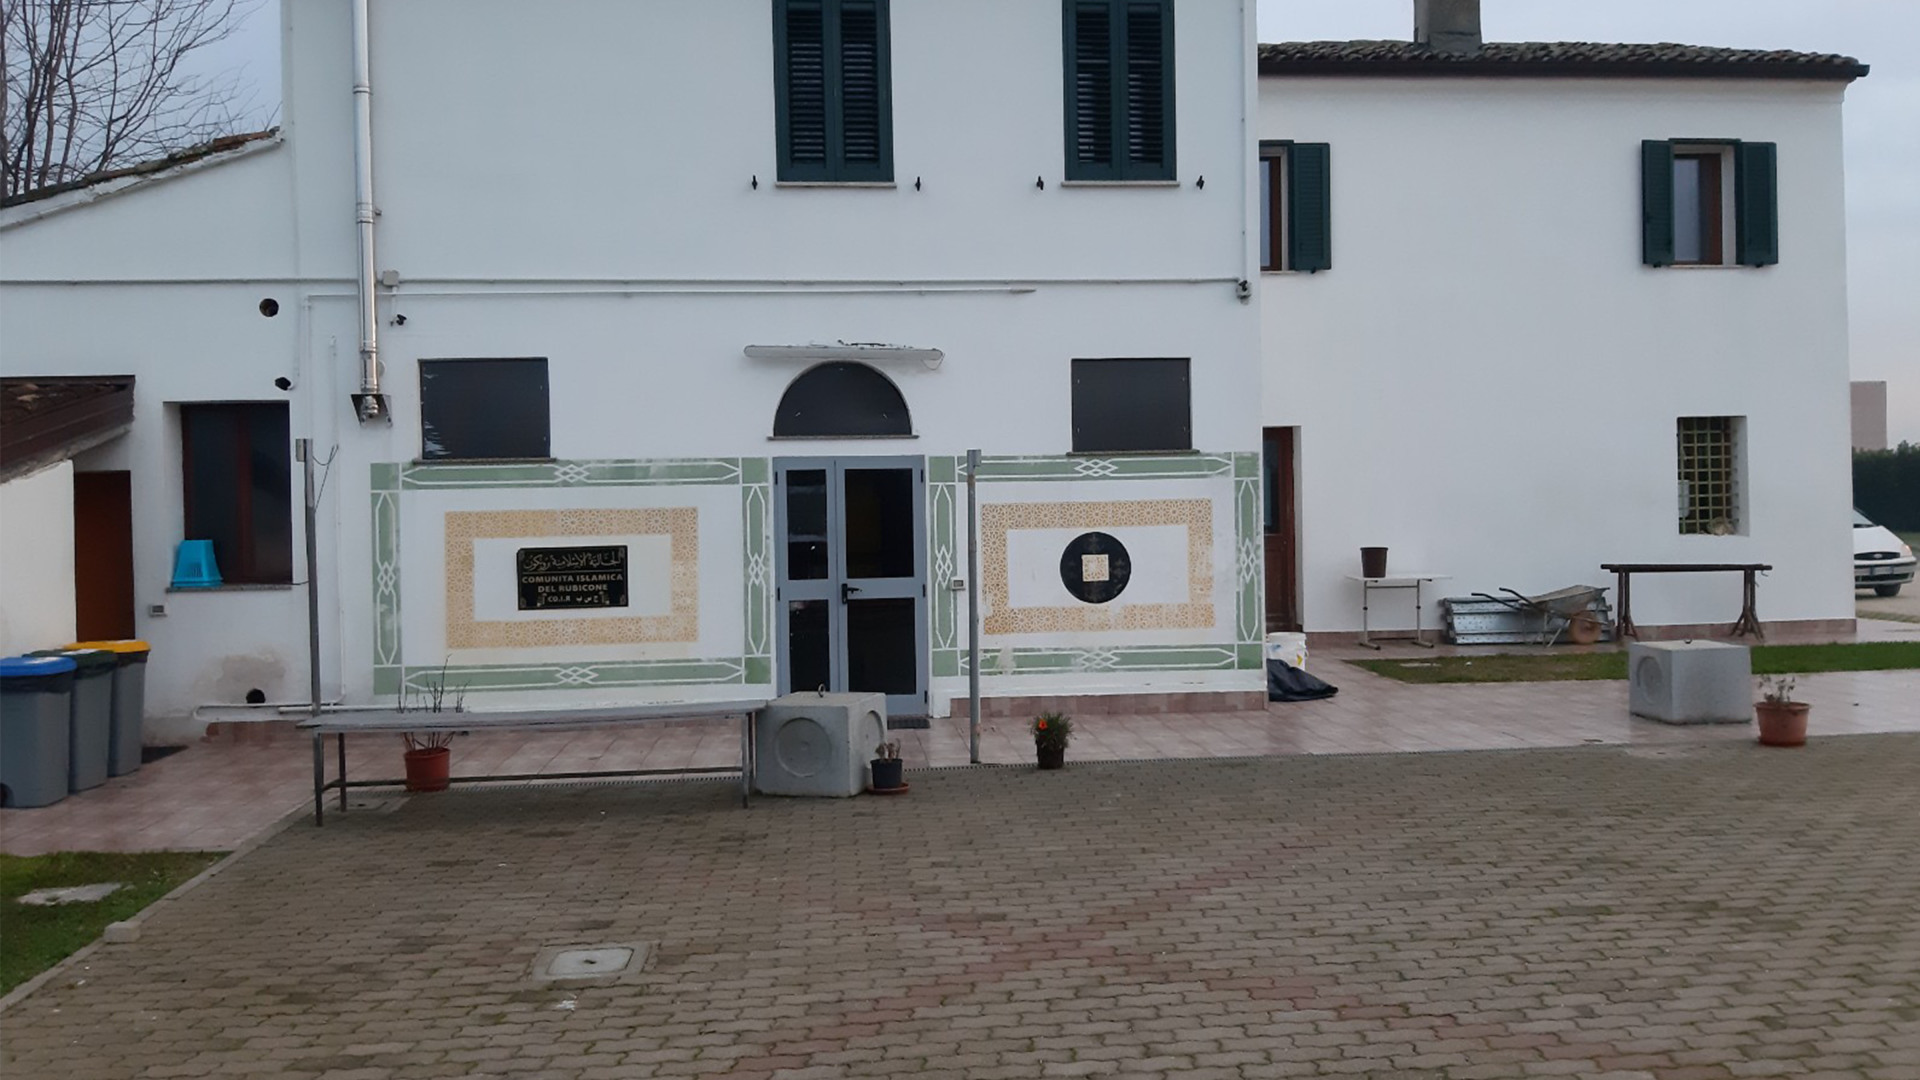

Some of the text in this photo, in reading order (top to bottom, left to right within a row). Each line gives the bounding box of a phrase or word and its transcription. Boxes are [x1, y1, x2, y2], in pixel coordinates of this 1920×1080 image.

[521, 573, 624, 584] COMUNITA ISLAMICA
[537, 584, 608, 593] DEL RUBICONE
